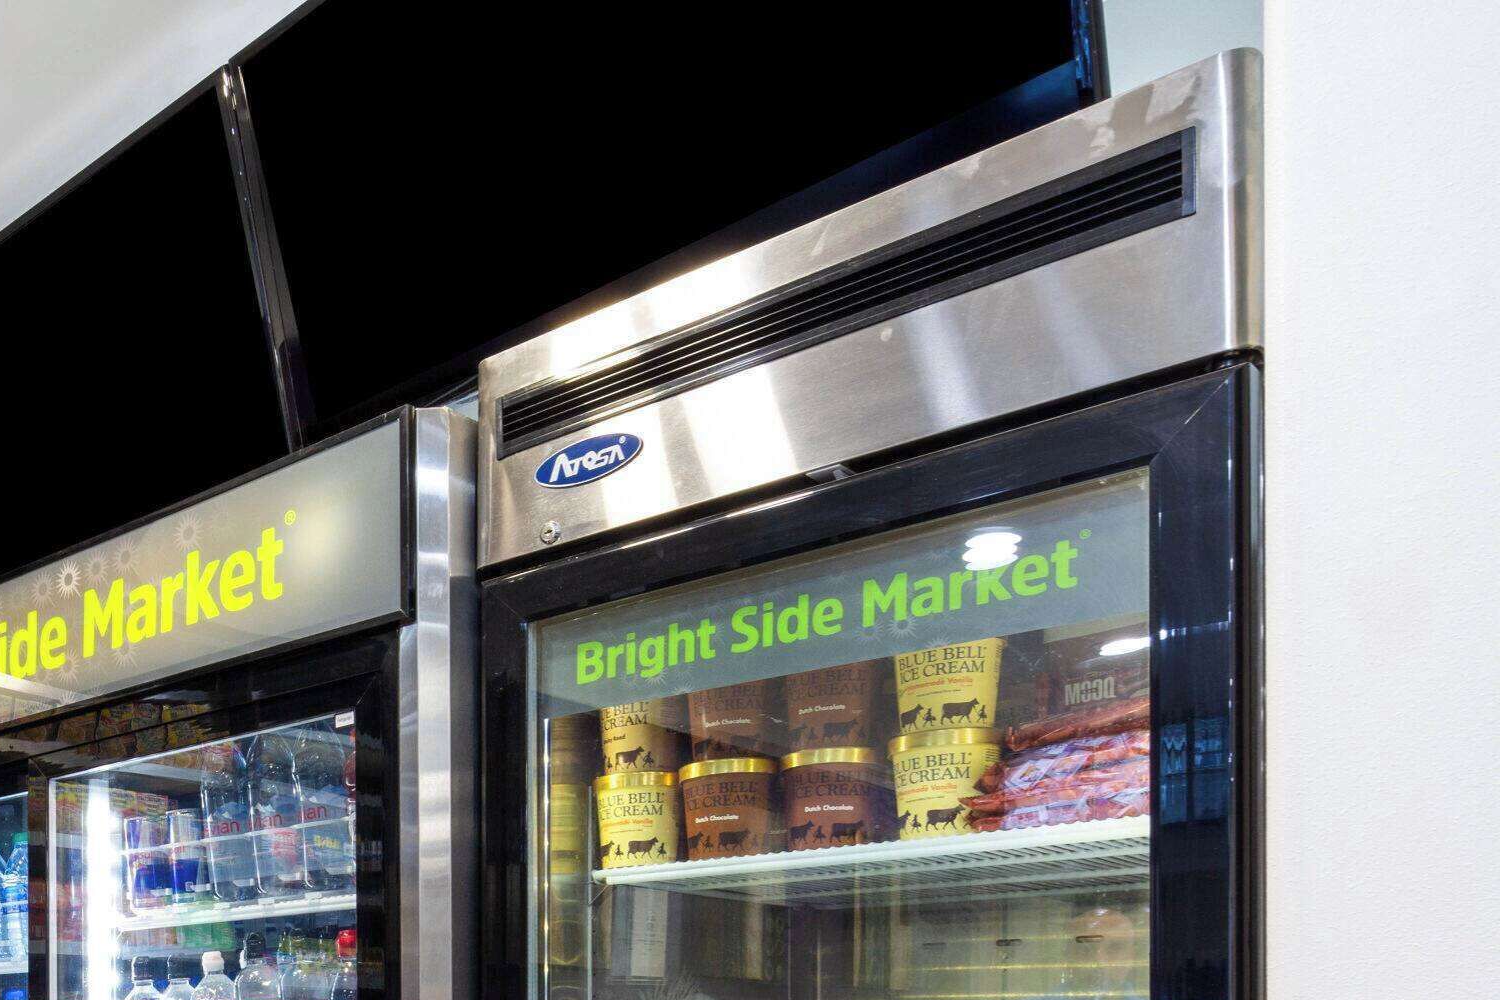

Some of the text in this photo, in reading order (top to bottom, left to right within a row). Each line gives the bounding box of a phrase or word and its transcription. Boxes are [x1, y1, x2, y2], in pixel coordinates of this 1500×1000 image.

[82, 527, 284, 657] Market
[576, 539, 1078, 684] Bright Side Market
[898, 646, 986, 669] BLUE BELL
[900, 660, 985, 684] ICE CREAM
[814, 704, 846, 713] Chocolate
[925, 752, 972, 767] BELL
[914, 766, 971, 784] CREAM
[628, 792, 663, 805] BELL
[621, 804, 664, 818] CREAM
[804, 803, 854, 813] Dutch Chocolate
[695, 813, 741, 825] Dutch Chocolate
